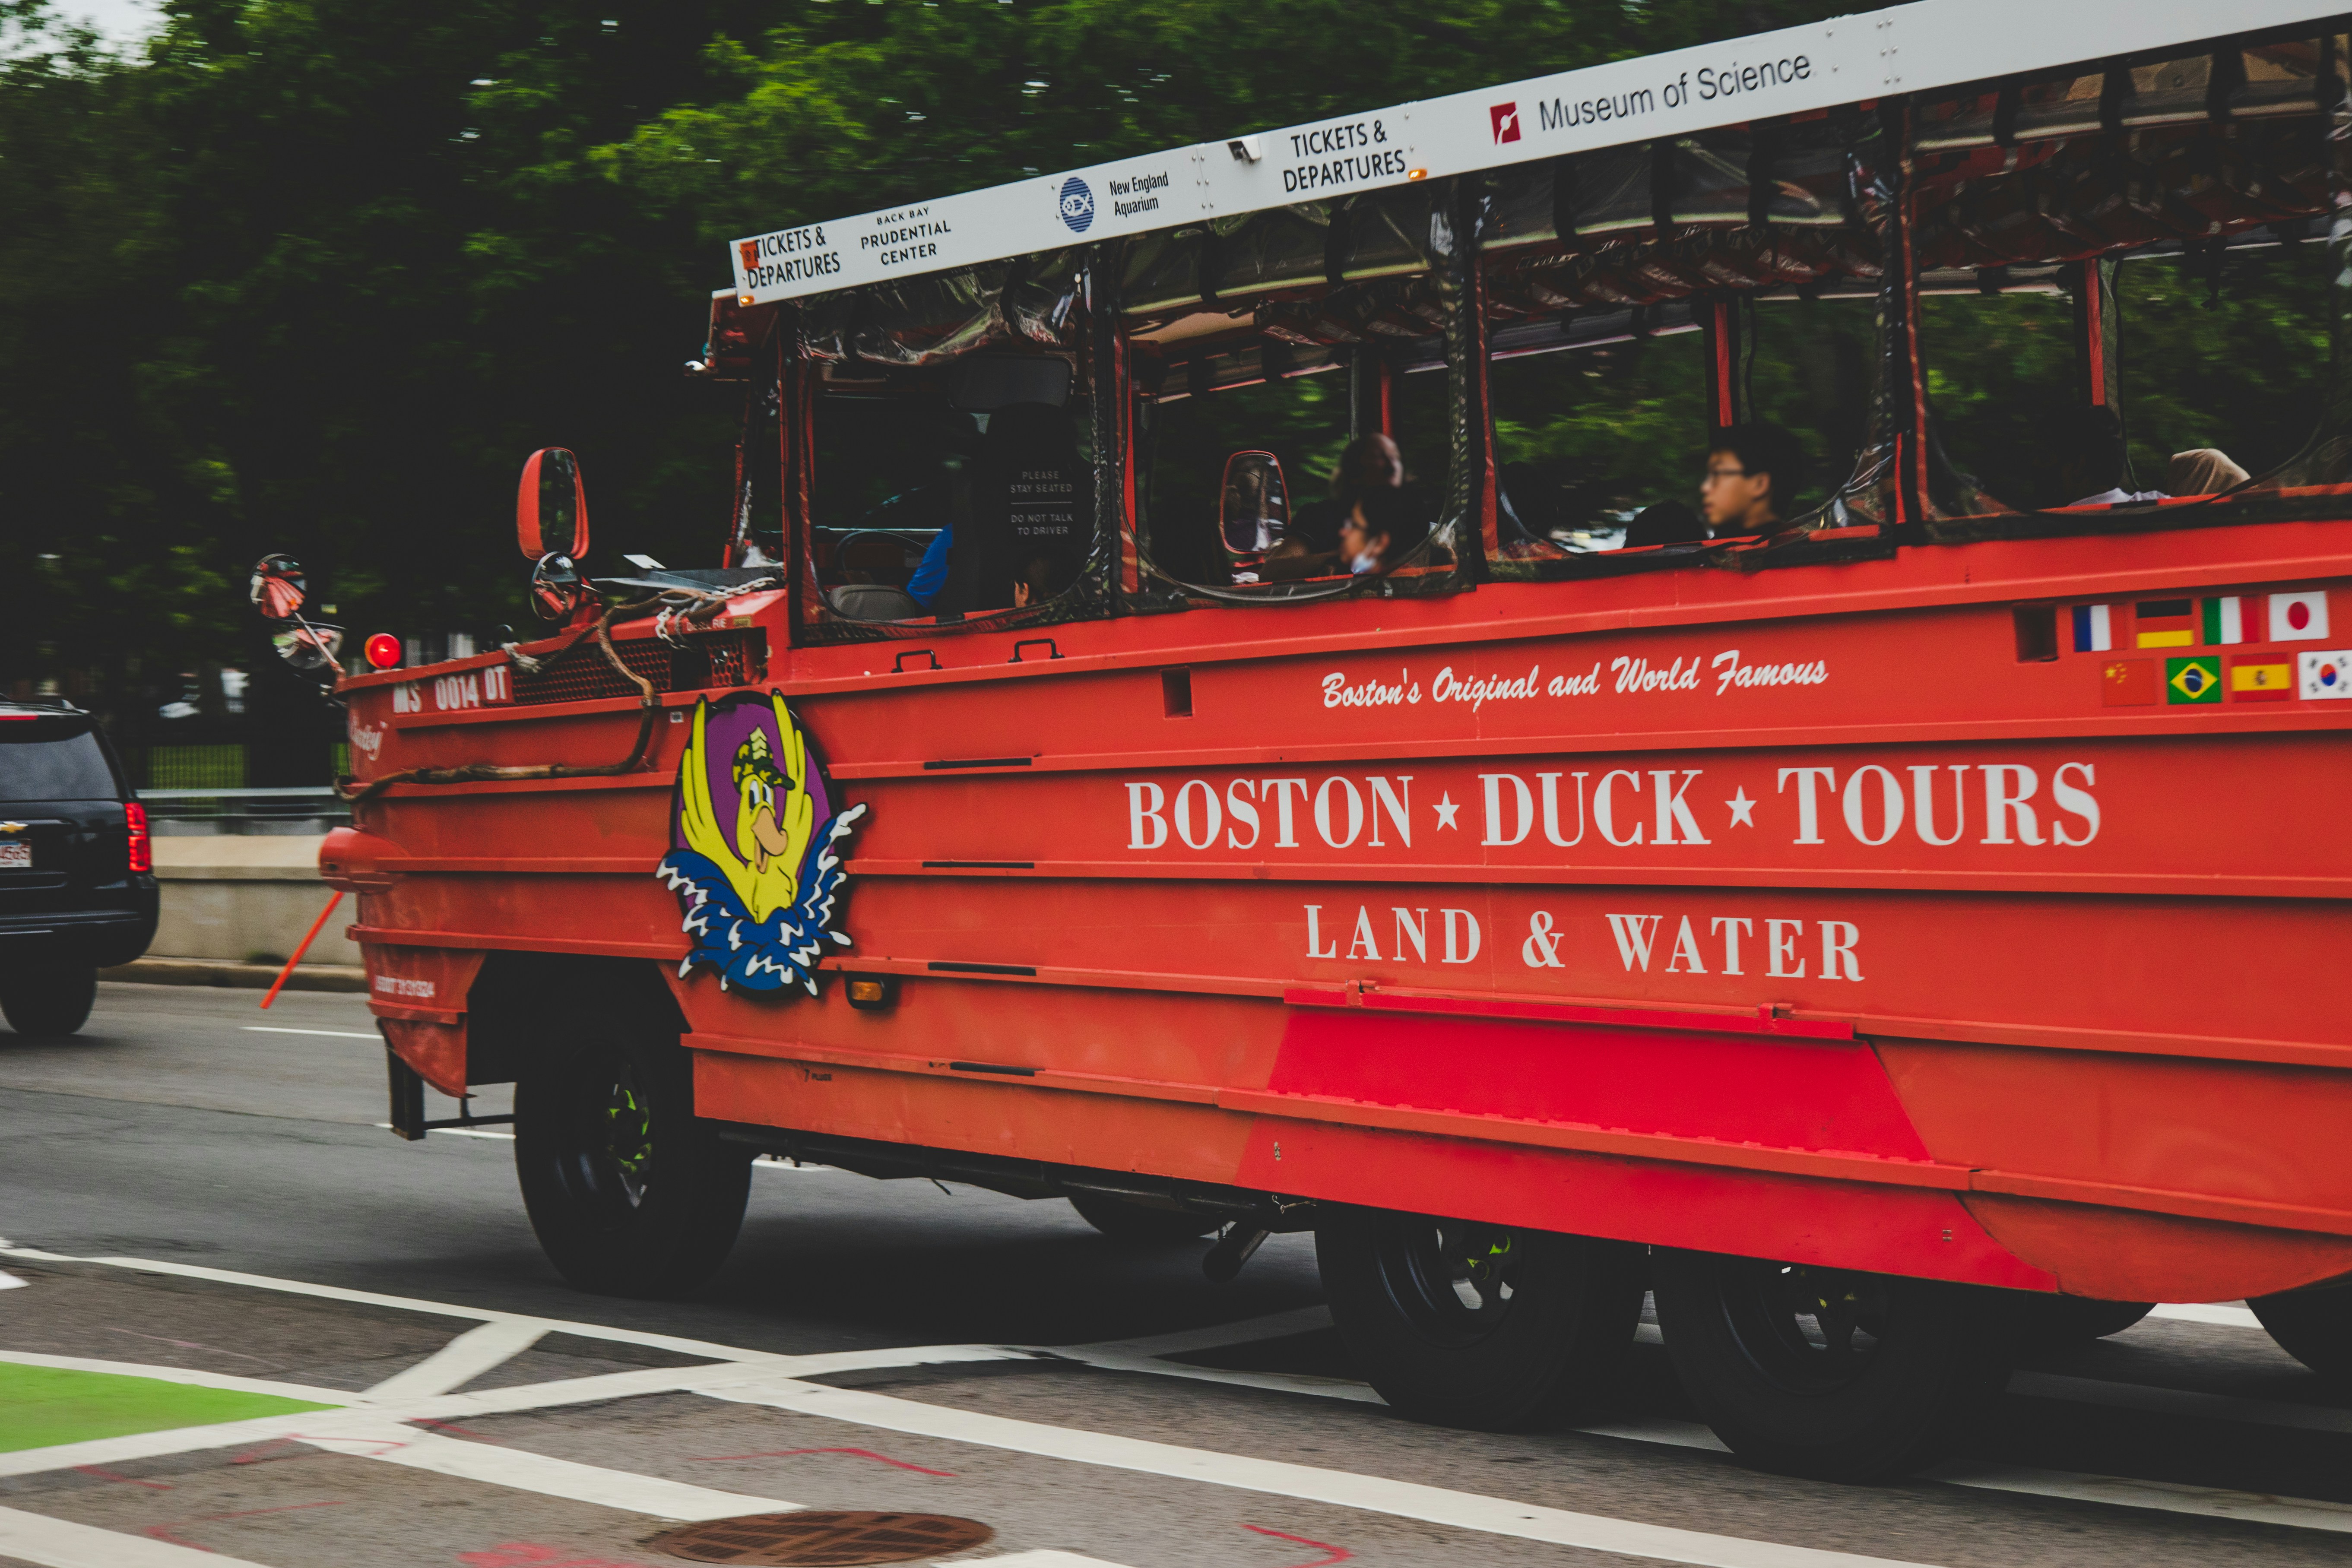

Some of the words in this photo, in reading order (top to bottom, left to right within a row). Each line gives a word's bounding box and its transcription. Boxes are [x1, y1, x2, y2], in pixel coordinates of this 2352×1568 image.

[1539, 89, 1654, 130] Museum
[1664, 72, 1687, 108] of
[1698, 55, 1810, 100] Science
[1290, 123, 1367, 157] TICKETS
[1374, 120, 1387, 143] &
[1109, 181, 1130, 196] New
[1132, 171, 1169, 193] England
[1283, 149, 1405, 192] DEPARTURES
[877, 214, 904, 225] BACK
[909, 208, 928, 218] BAY
[1115, 198, 1159, 217] Aquarium
[754, 228, 811, 259] TICKETS
[815, 225, 826, 246] &
[861, 220, 951, 249] PRUDENTIAL
[881, 243, 936, 265] CENTER
[746, 252, 840, 289] DEPARTURES
[1010, 485, 1032, 493] STAY
[1036, 484, 1073, 493] SEATED
[1022, 471, 1059, 480] PLEASE
[1017, 527, 1030, 535] TO
[1033, 526, 1069, 535] DRIVER
[1050, 513, 1073, 522] TALK
[393, 681, 422, 713] MS
[435, 675, 480, 711] 0014
[1322, 668, 1422, 708] Boston's
[1432, 665, 1539, 713] Original
[1547, 662, 1601, 697] and
[1611, 656, 1700, 694] World
[1712, 650, 1829, 696] Famous
[1125, 776, 1413, 850] BOSTON
[1478, 770, 1712, 847] DUCK
[1778, 762, 2100, 846] TOURS
[1304, 905, 1480, 963] LAND
[1522, 911, 1566, 968] &
[1605, 914, 1864, 982] WATER
